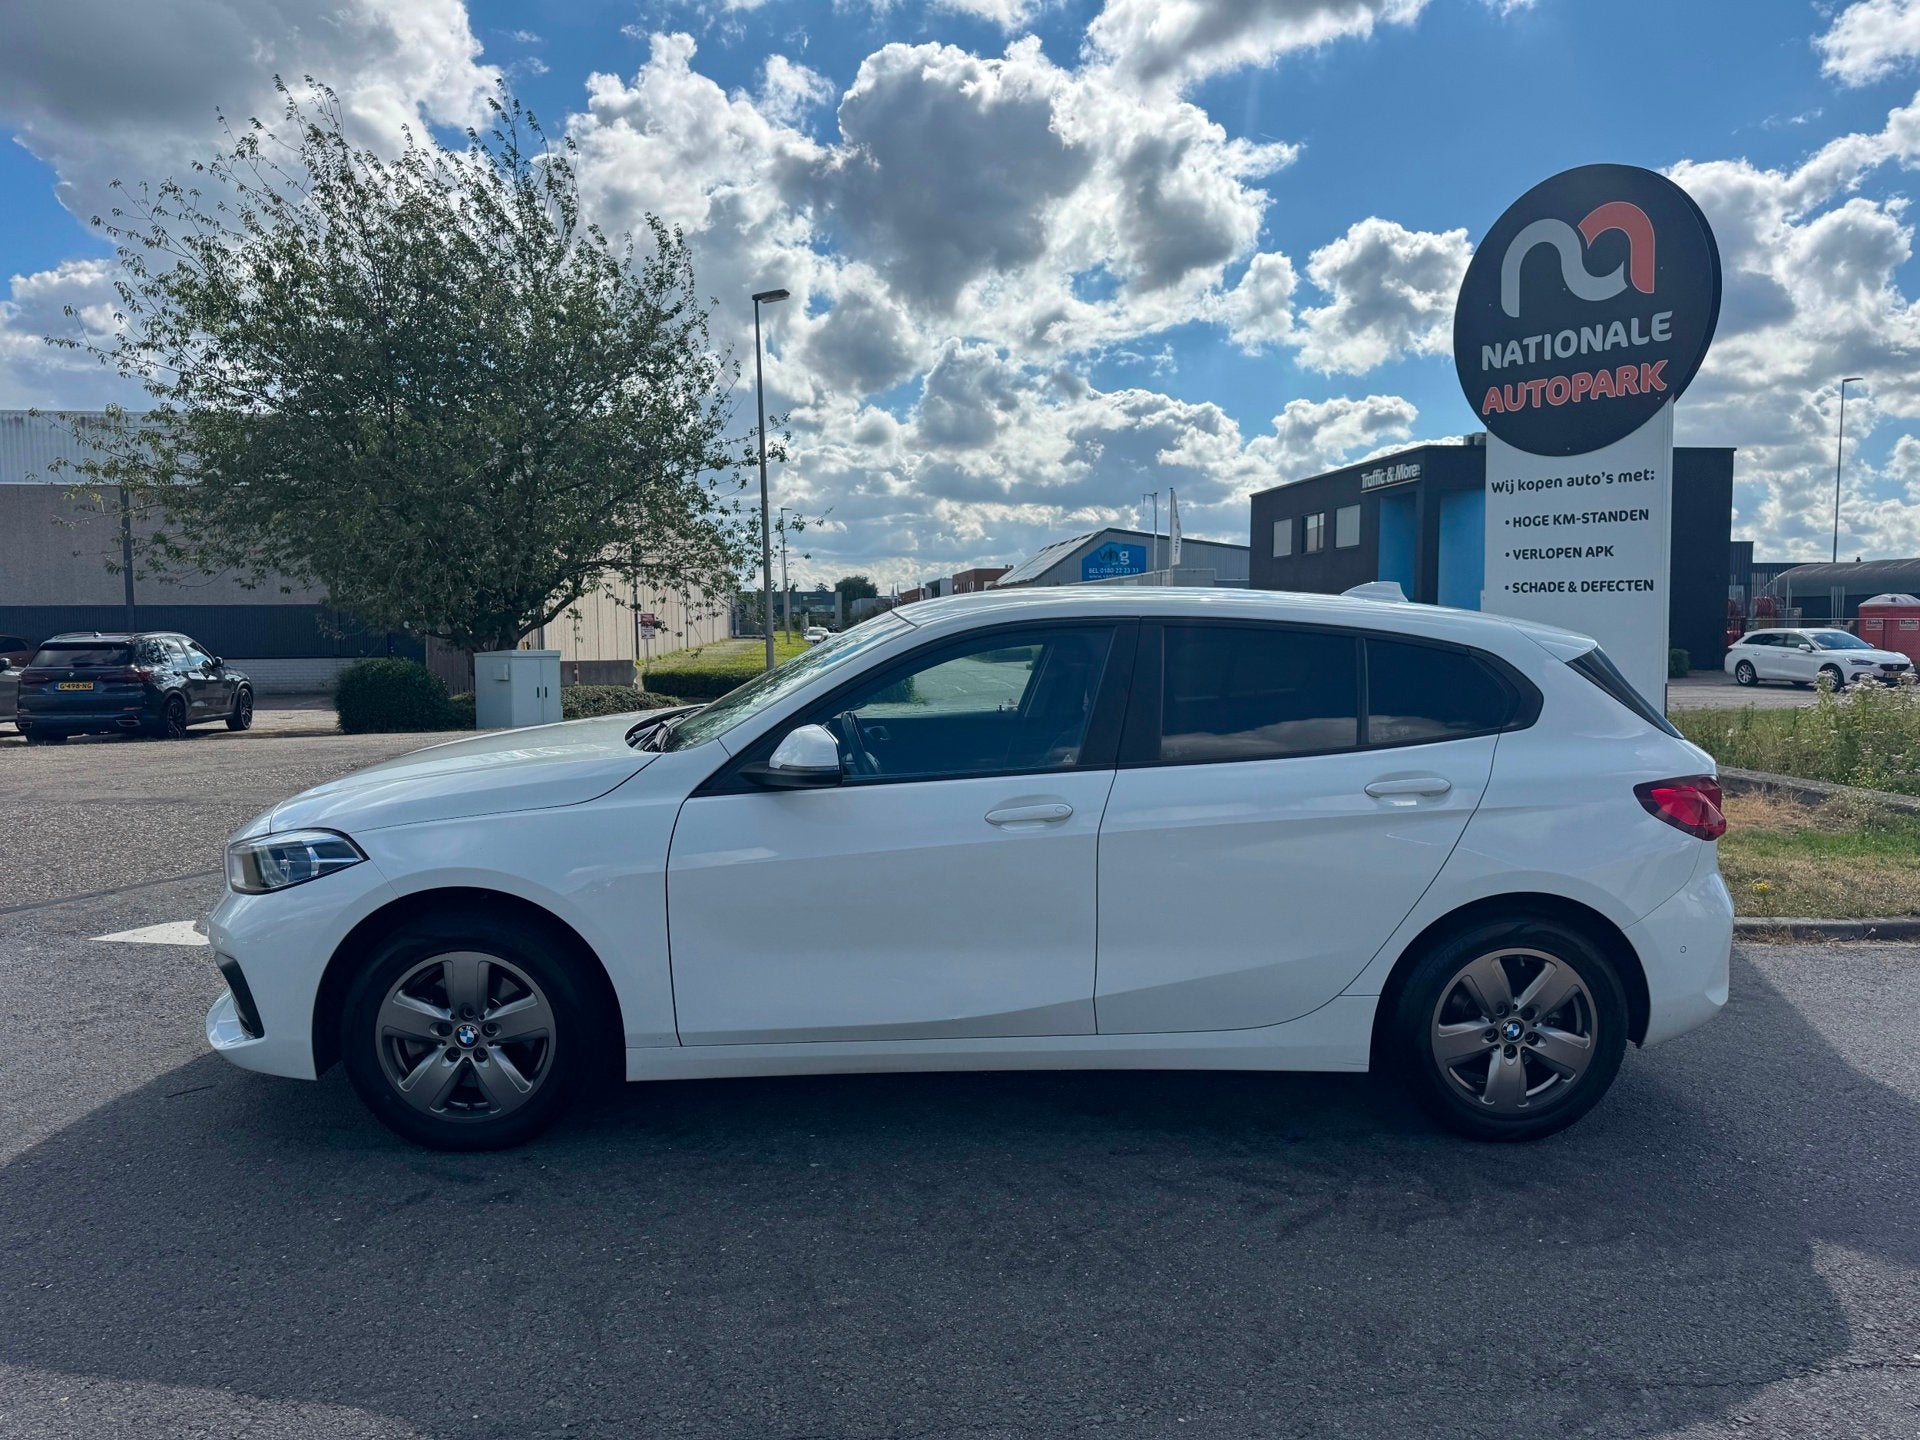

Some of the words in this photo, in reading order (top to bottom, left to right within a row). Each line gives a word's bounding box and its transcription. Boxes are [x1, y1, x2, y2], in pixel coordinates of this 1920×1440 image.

[1481, 310, 1673, 371] NATIONALE
[1482, 359, 1669, 415] AUTOPARK
[1361, 469, 1387, 489] Traffic
[1386, 466, 1396, 483] &
[1395, 463, 1421, 480] More
[1491, 479, 1515, 495] Wij
[1517, 477, 1563, 492] kopen
[1566, 472, 1613, 487] auto's
[1618, 468, 1655, 483] met:
[1512, 515, 1550, 528] HOGE
[1553, 508, 1649, 526] KM-STANDEN
[1512, 546, 1582, 560] VERLOPEN
[1585, 545, 1614, 558] APK
[1512, 581, 1565, 593] SCHADE
[1568, 582, 1577, 593] &
[1580, 579, 1655, 593] DEFECTEN
